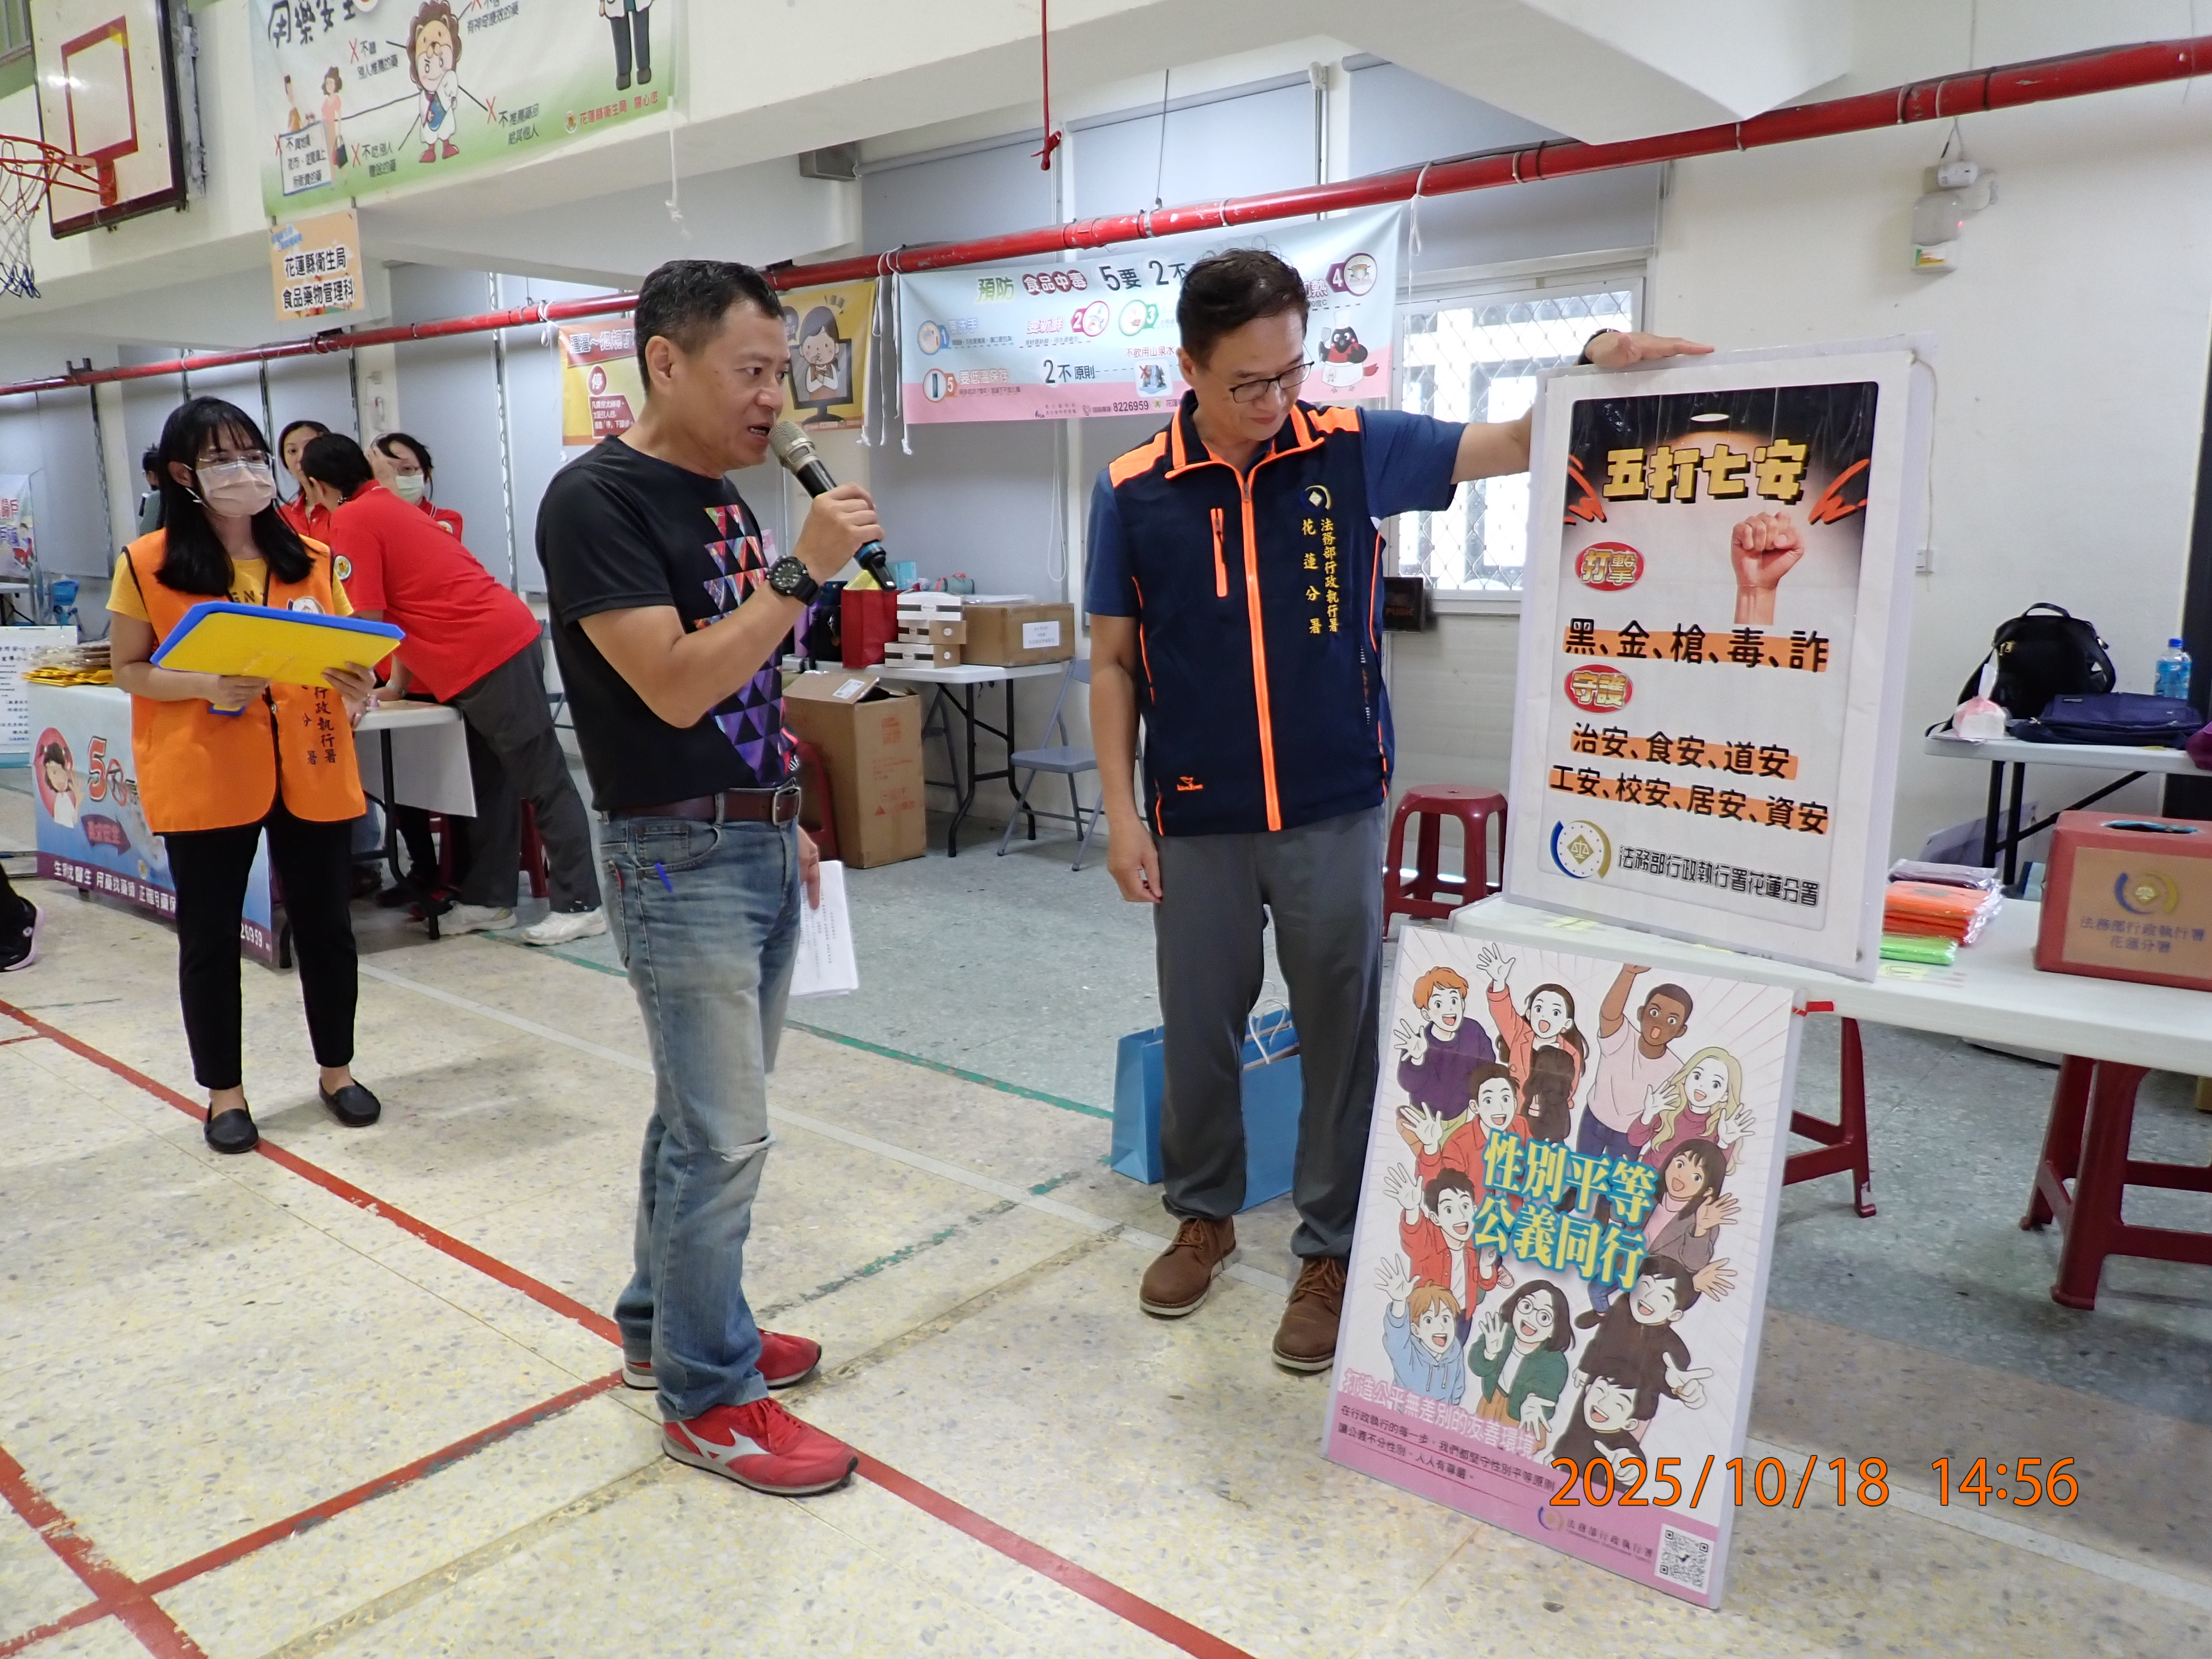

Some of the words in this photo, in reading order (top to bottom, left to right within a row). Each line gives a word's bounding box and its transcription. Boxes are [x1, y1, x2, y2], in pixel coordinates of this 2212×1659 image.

[284, 247, 347, 279] 花蓮縣衛生局
[1332, 269, 1343, 287] 4
[283, 277, 354, 309] 食品藥物管理科
[977, 277, 1015, 302] 預防
[1023, 270, 1088, 295] 食品中毒
[1026, 317, 1064, 334] 要新鮮
[1072, 311, 1082, 330] 2
[1146, 307, 1156, 321] 3
[1126, 346, 1175, 358] 不飲用山泉水
[592, 373, 603, 389] 停
[947, 377, 954, 393] 5
[959, 368, 1009, 385] 要低溫保存
[1043, 359, 1095, 384] 2不原則
[1113, 401, 1149, 412] 8226959
[1603, 439, 1809, 506] 五打七安
[1302, 518, 1322, 634] 花蓮分署
[1321, 518, 1339, 633] 法務部行政執行署
[1579, 549, 1638, 586] 打擊
[1564, 618, 1829, 674] 黑、金、槍、毒、詐
[1569, 670, 1628, 709] 守護
[1573, 722, 1790, 780] 治安、食安、道安
[1550, 764, 1828, 835] 工安、校安、居安、資安
[1617, 844, 1820, 907] 法務部行政執行署花蓮分署
[2080, 916, 2206, 941] 法務部行政執行署
[2110, 935, 2171, 953] 花蓮分署
[1483, 1130, 1656, 1224] 性別平等
[1474, 1197, 1645, 1290] 公義同行
[1343, 1368, 1536, 1459] 打造公平無差別的友善環境
